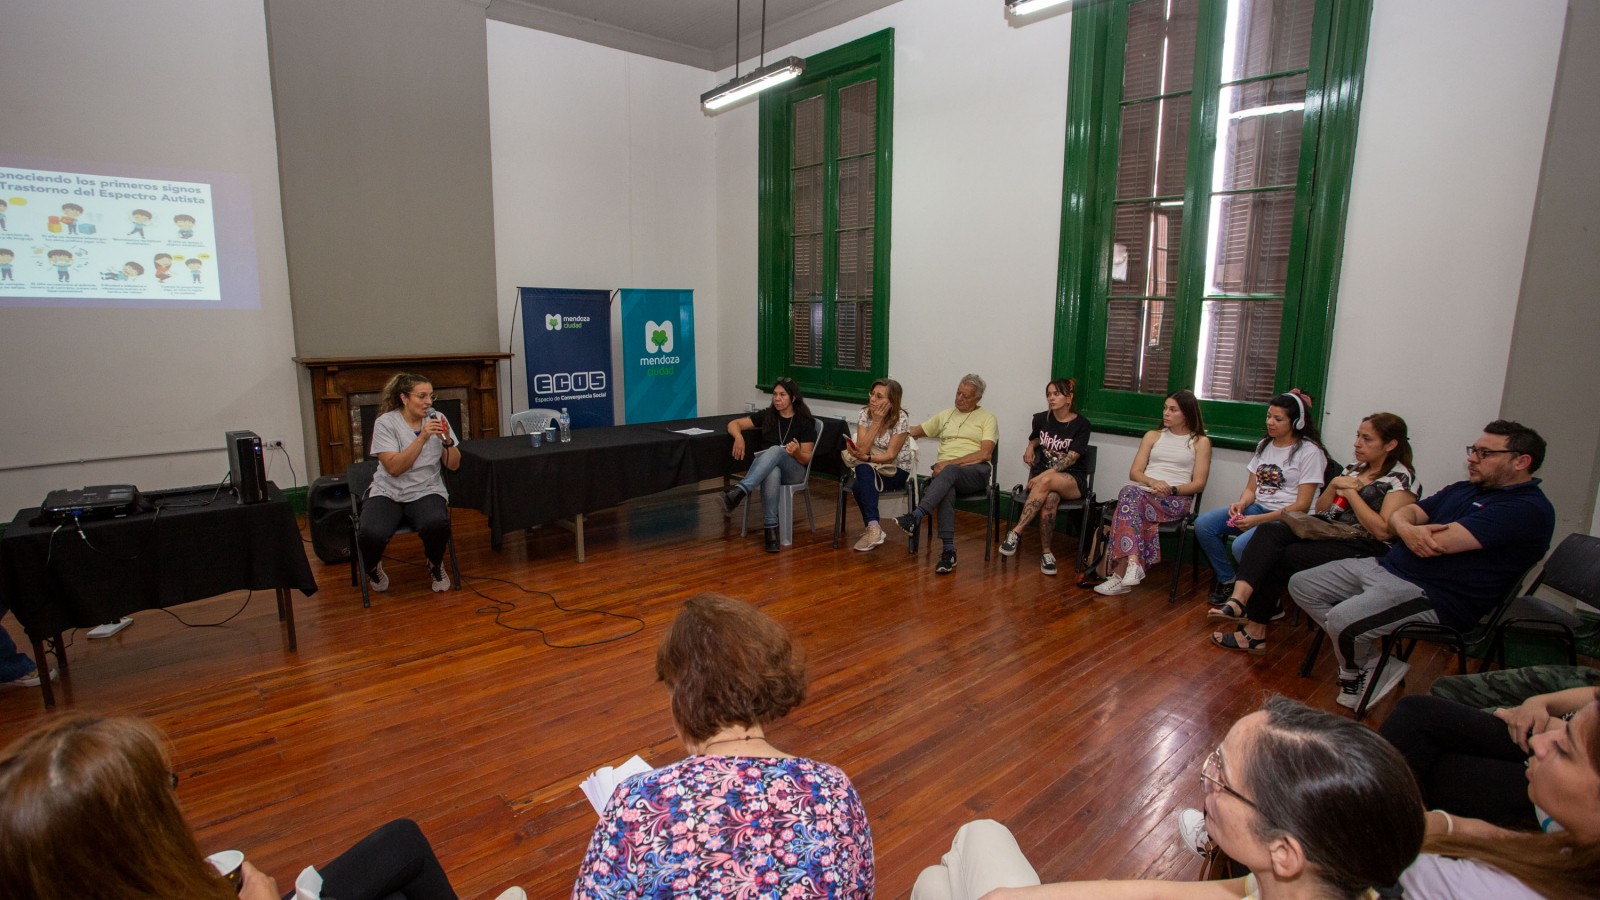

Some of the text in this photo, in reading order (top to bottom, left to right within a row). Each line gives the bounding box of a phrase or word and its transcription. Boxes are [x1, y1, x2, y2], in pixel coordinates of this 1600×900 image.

[76, 176, 96, 186] los
[100, 180, 158, 190] primeros
[162, 184, 202, 194] signos
[0, 182, 205, 204] Trastorno del Espectro Autista
[640, 355, 680, 366] mendoza
[647, 367, 674, 376] ciudad
[534, 371, 606, 394] ECOS
[561, 393, 593, 401] Convergencia
